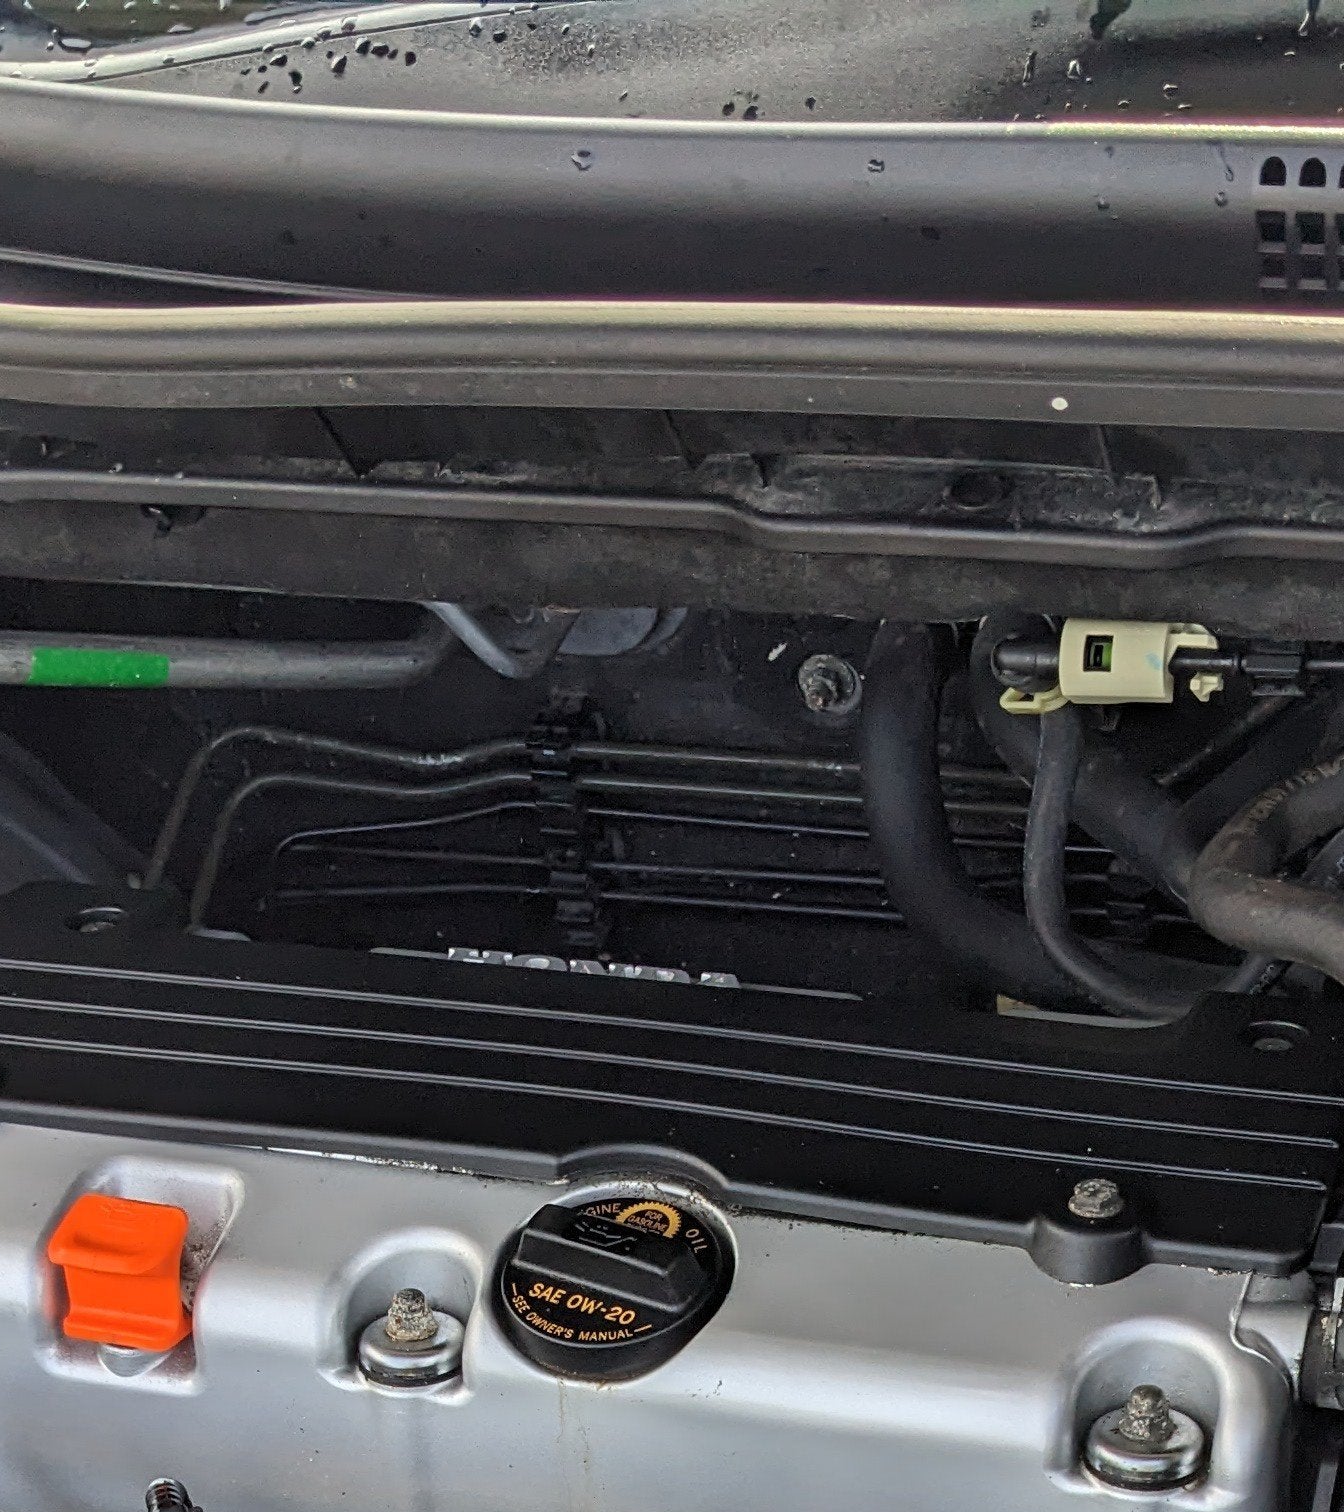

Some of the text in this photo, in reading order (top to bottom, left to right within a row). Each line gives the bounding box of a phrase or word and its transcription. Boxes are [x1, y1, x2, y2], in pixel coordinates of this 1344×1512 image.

[627, 1215, 669, 1232] GASOLINE
[644, 1210, 664, 1220] FOR
[578, 1203, 622, 1218] GINE
[685, 1228, 708, 1254] OIL
[528, 1282, 567, 1305] SAE
[525, 1311, 575, 1340] OWNER'S
[578, 1328, 635, 1342] MANUAL
